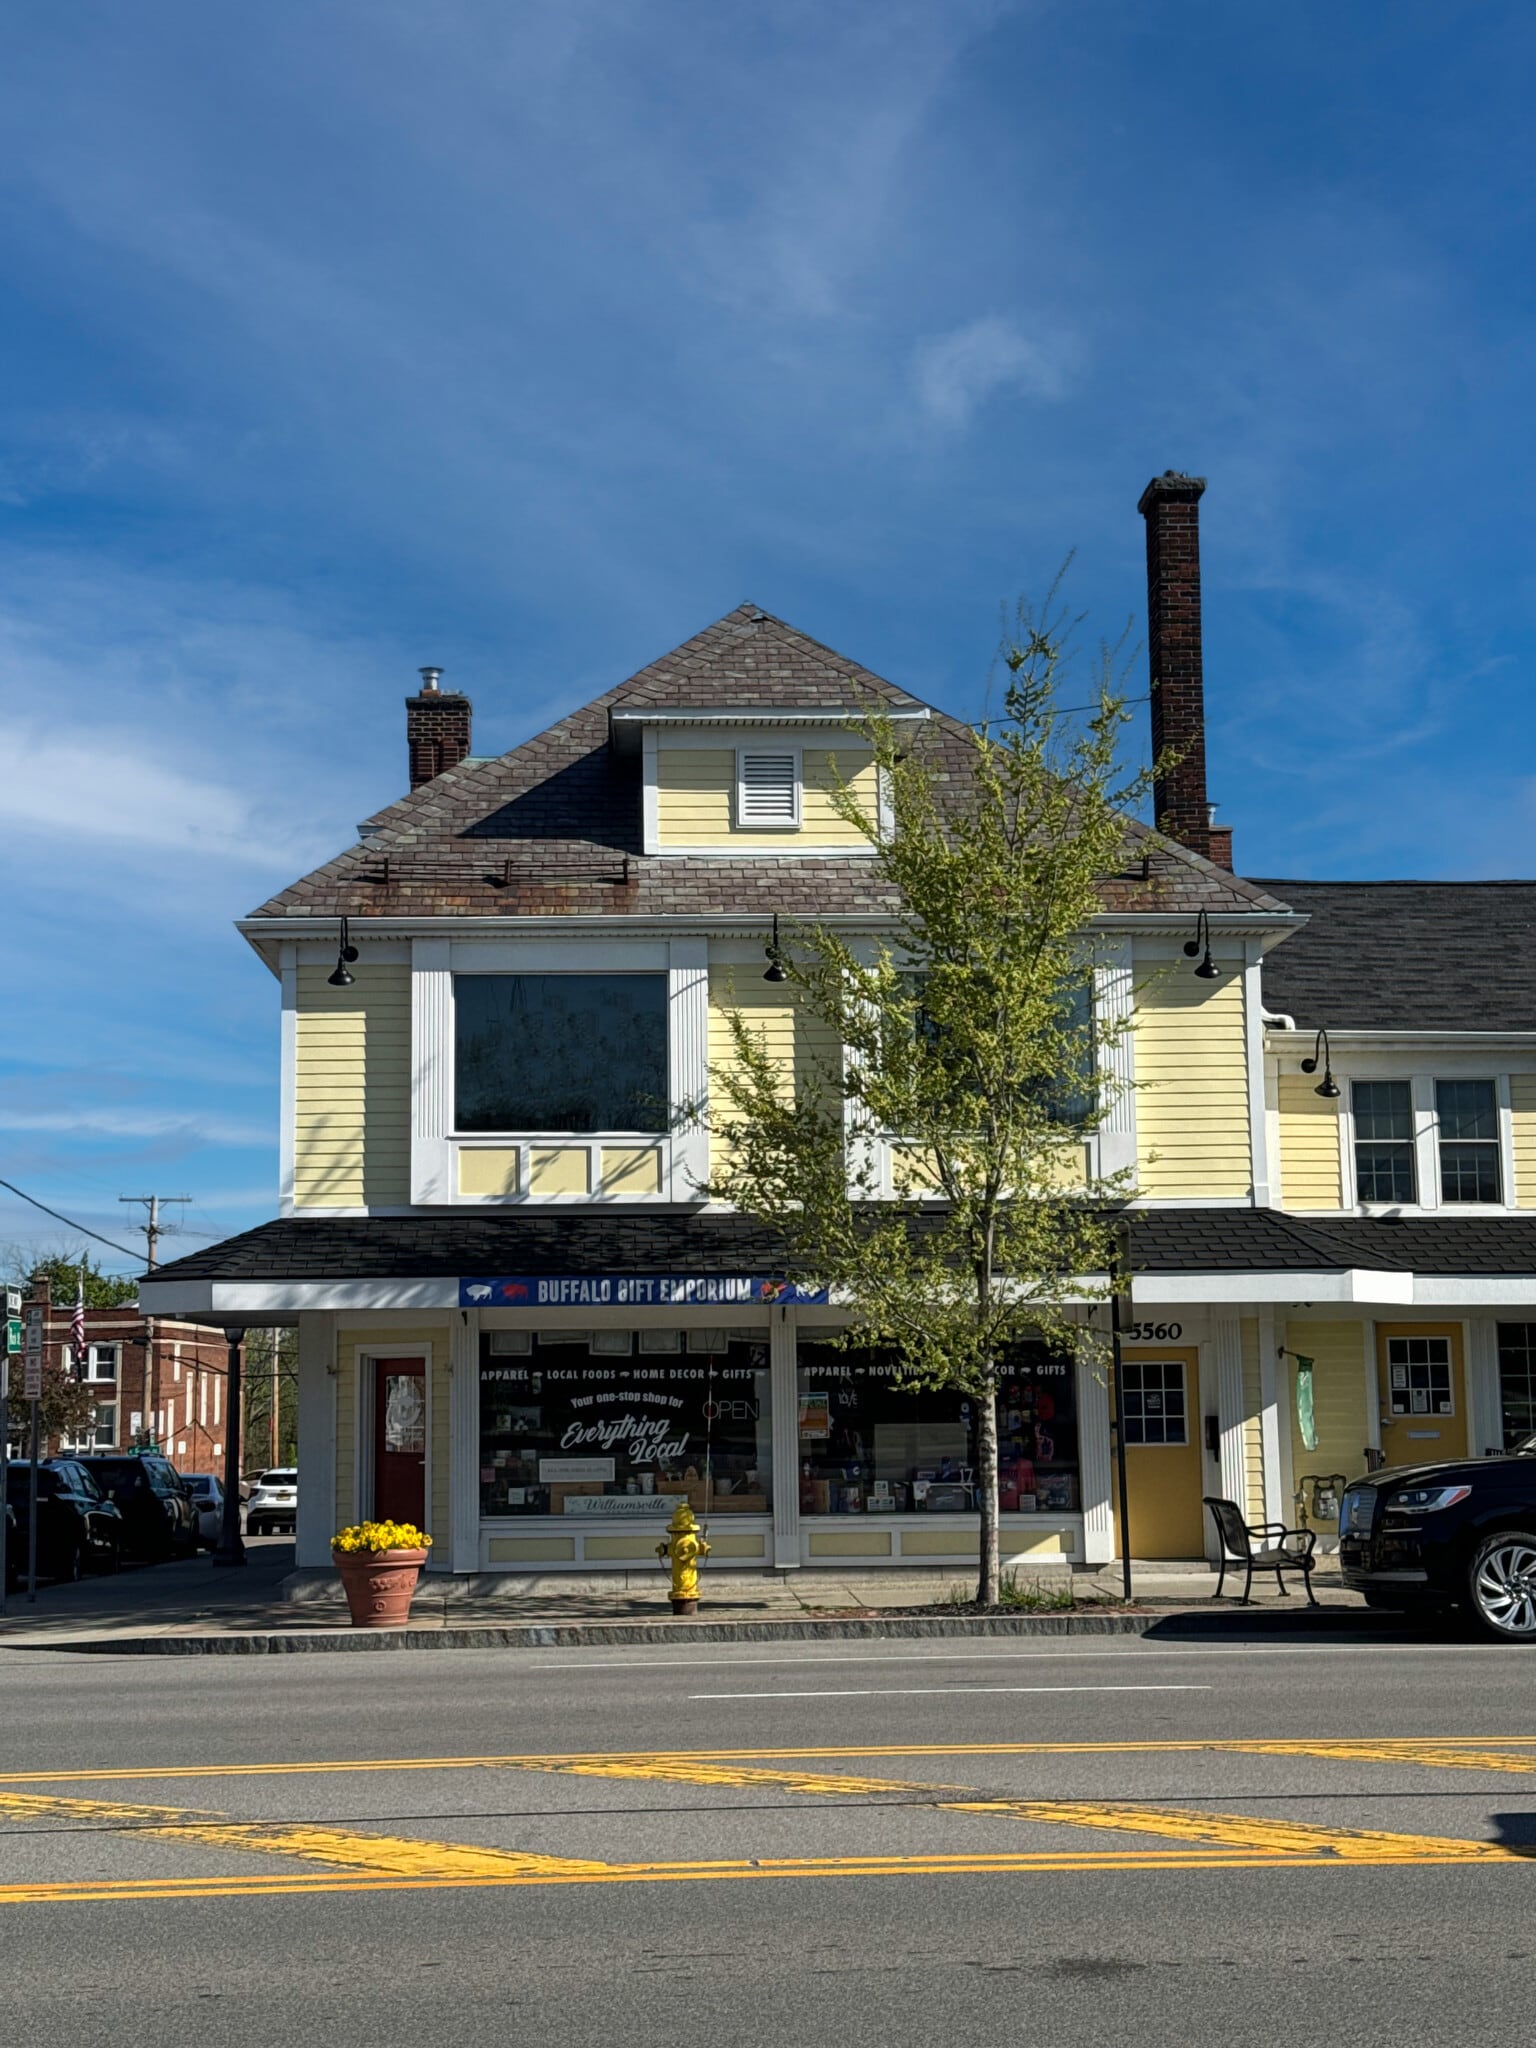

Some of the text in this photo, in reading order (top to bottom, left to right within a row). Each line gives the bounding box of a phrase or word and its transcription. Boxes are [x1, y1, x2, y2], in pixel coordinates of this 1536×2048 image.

[538, 1278, 751, 1302] BUFFALO GIFT EMPORIUM
[1129, 1322, 1183, 1340] 5560
[481, 1369, 752, 1380] APPAREL LOCAL FOODS HOME DECOR GIFTS
[804, 1366, 852, 1377] APPAREL
[1036, 1365, 1066, 1375] GIFTS
[570, 1391, 684, 1408] Your one-stop shop for
[702, 1400, 760, 1420] OPEN
[560, 1413, 670, 1449] Everything
[628, 1432, 690, 1464] Local
[959, 1467, 974, 1483] 17
[584, 1497, 666, 1511] Williamsville
